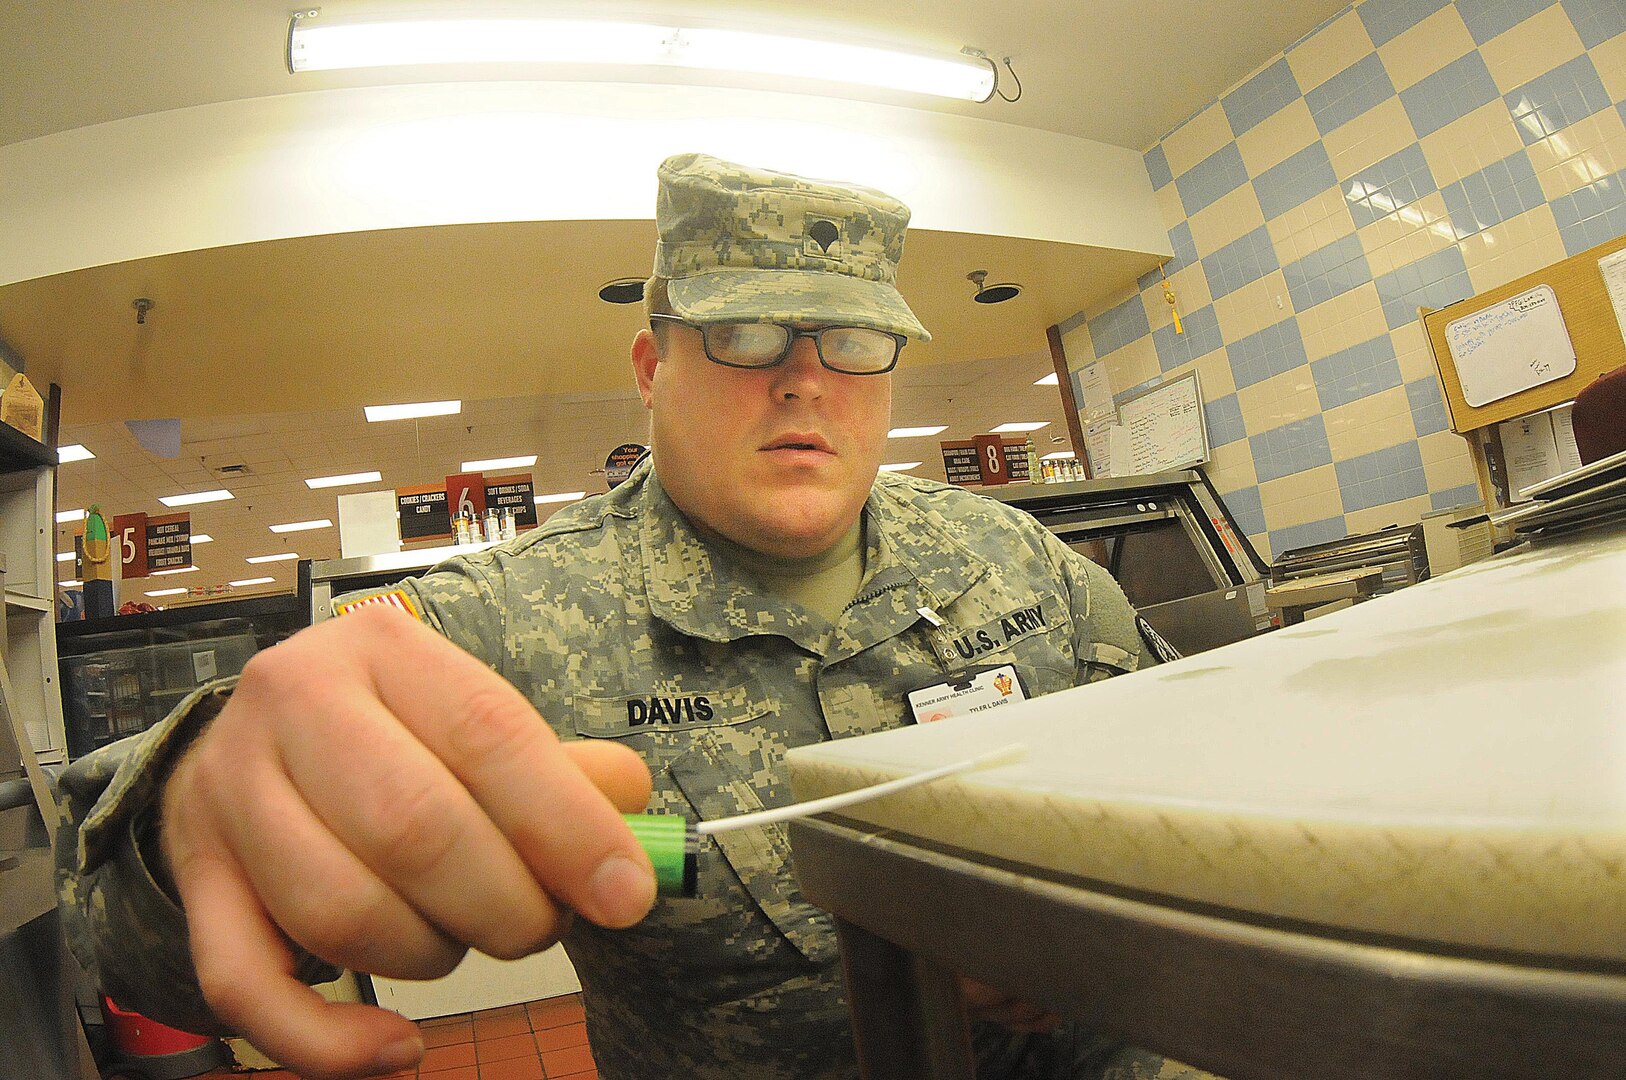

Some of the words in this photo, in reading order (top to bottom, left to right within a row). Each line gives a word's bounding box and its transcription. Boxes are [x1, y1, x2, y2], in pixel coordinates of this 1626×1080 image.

[986, 445, 1000, 474] 8
[416, 505, 431, 514] CANDY
[458, 487, 474, 514] 6
[497, 496, 522, 505] BEVERAGES
[122, 527, 136, 564] 5
[953, 629, 1001, 659] U.S.
[1001, 605, 1046, 642] ARMY
[915, 698, 936, 708] KENNER
[936, 695, 950, 703] ARMY
[950, 690, 969, 699] HEALTH
[969, 685, 984, 694] CLINIC
[969, 703, 988, 713] TYLER
[992, 698, 1009, 708] DAVIS
[627, 696, 714, 727] DAVIS
